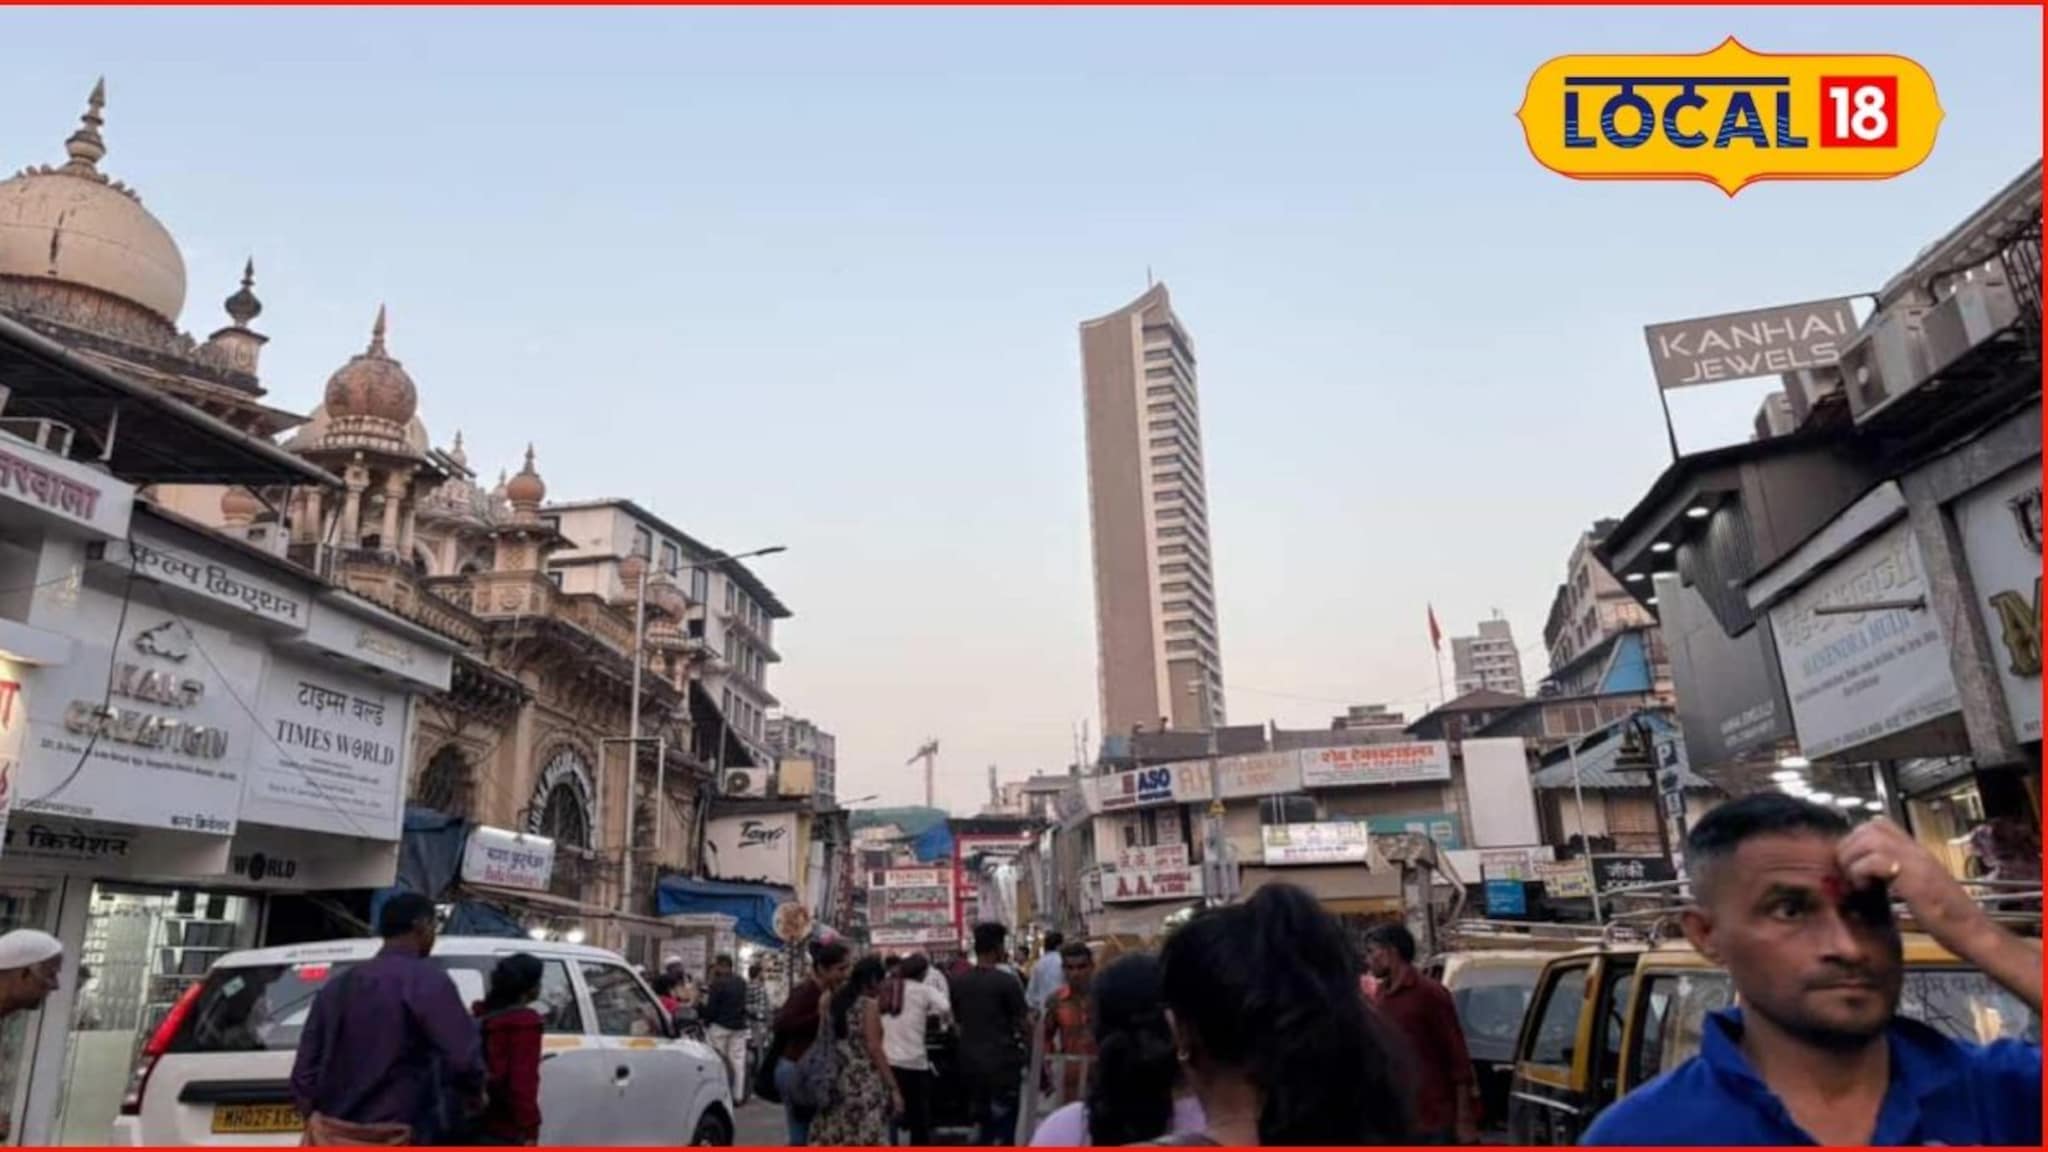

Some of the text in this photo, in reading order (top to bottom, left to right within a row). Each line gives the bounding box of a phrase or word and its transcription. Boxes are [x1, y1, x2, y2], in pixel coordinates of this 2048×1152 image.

[1659, 310, 1847, 359] KANHAI
[1680, 341, 1841, 383] JEWELS
[110, 662, 205, 710] KALP
[298, 681, 348, 716] टाइम्स
[63, 699, 230, 761] CREATION
[274, 718, 395, 767] TIMES WORLD
[1137, 767, 1172, 793] ASO
